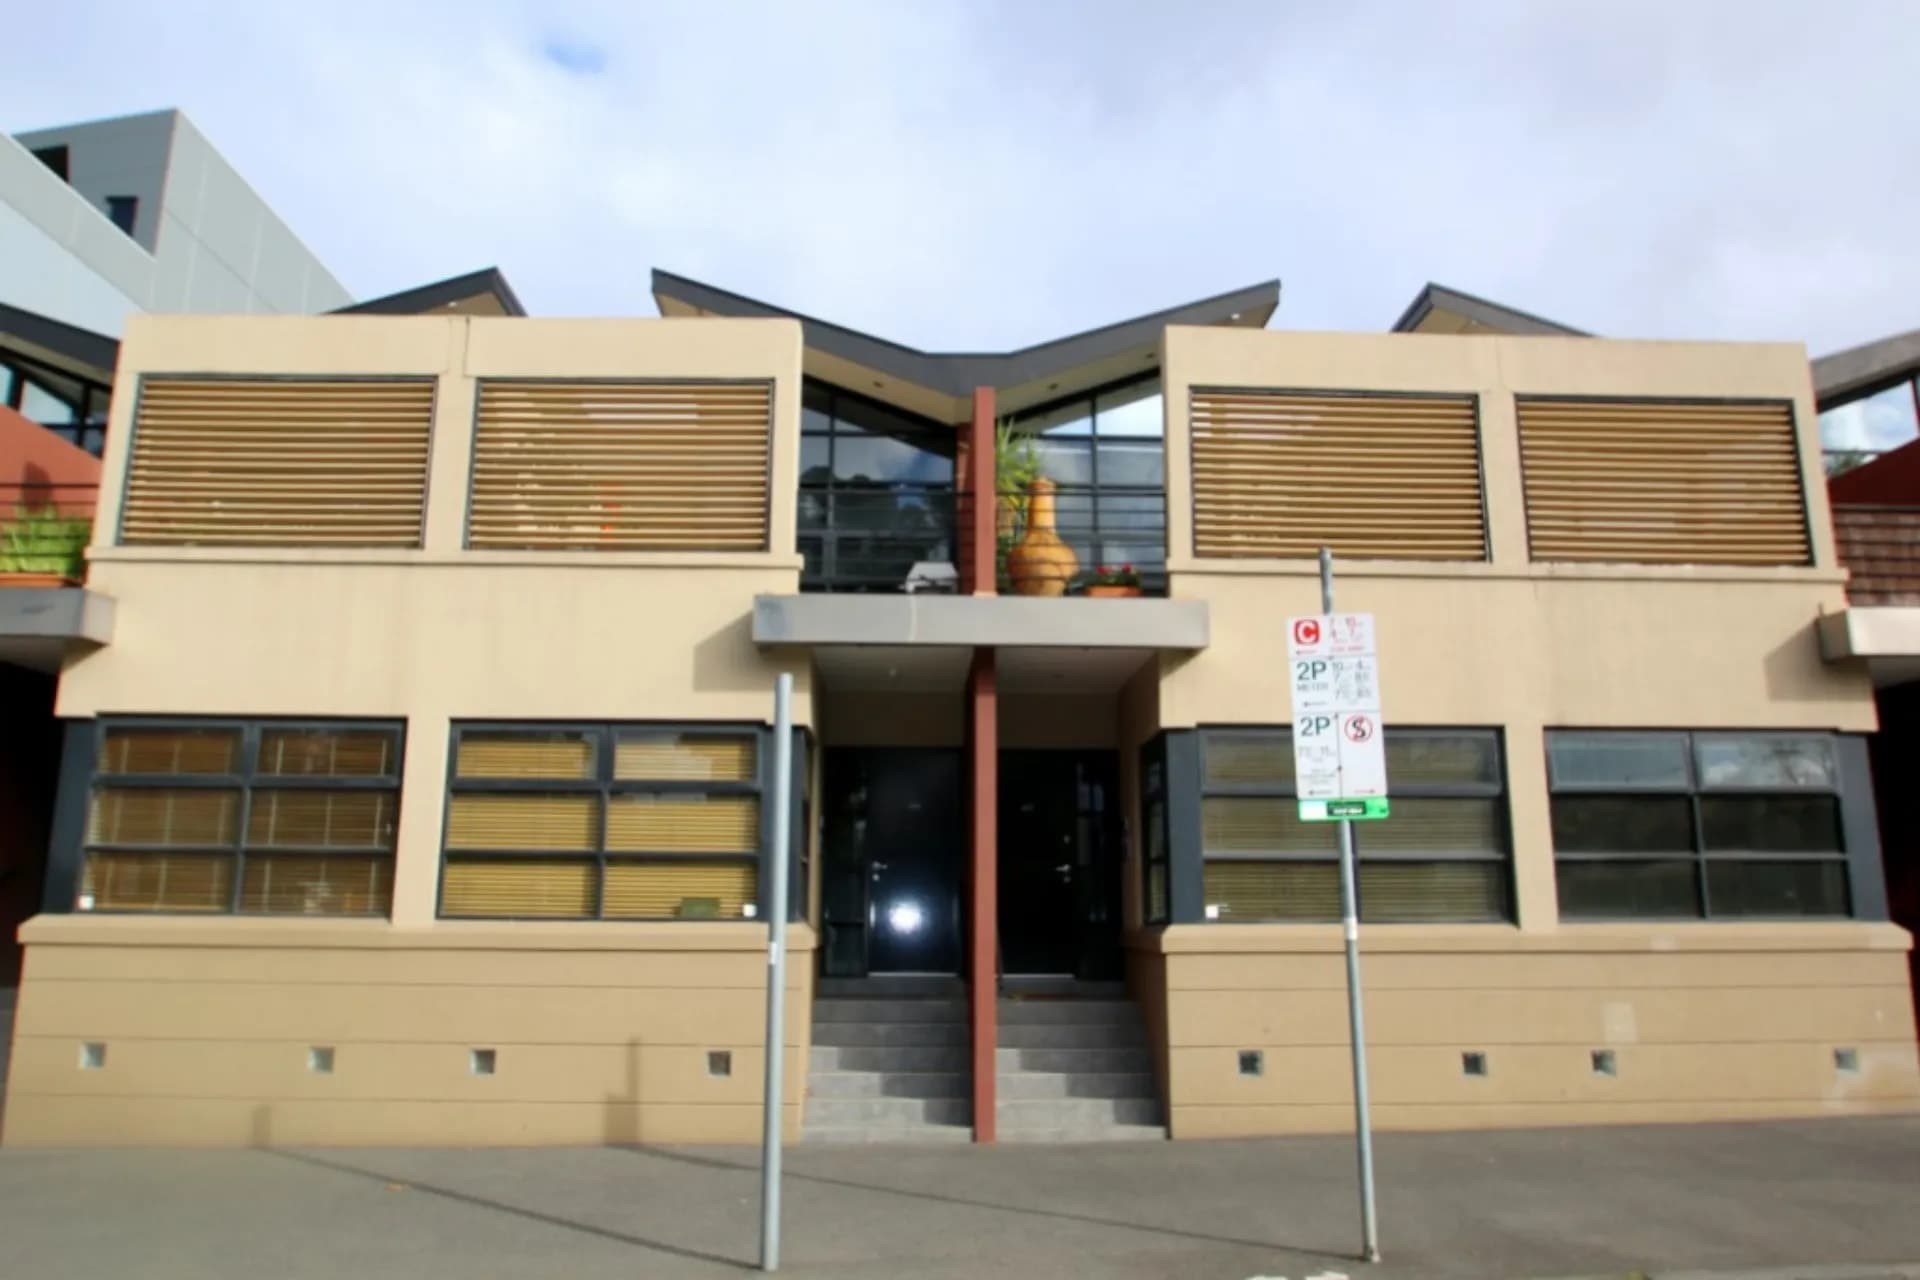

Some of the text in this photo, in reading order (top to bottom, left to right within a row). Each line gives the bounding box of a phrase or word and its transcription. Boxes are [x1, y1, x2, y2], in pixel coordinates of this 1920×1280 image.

[1297, 621, 1319, 643] C
[1296, 661, 1327, 681] 2P
[1300, 716, 1331, 737] 2P
